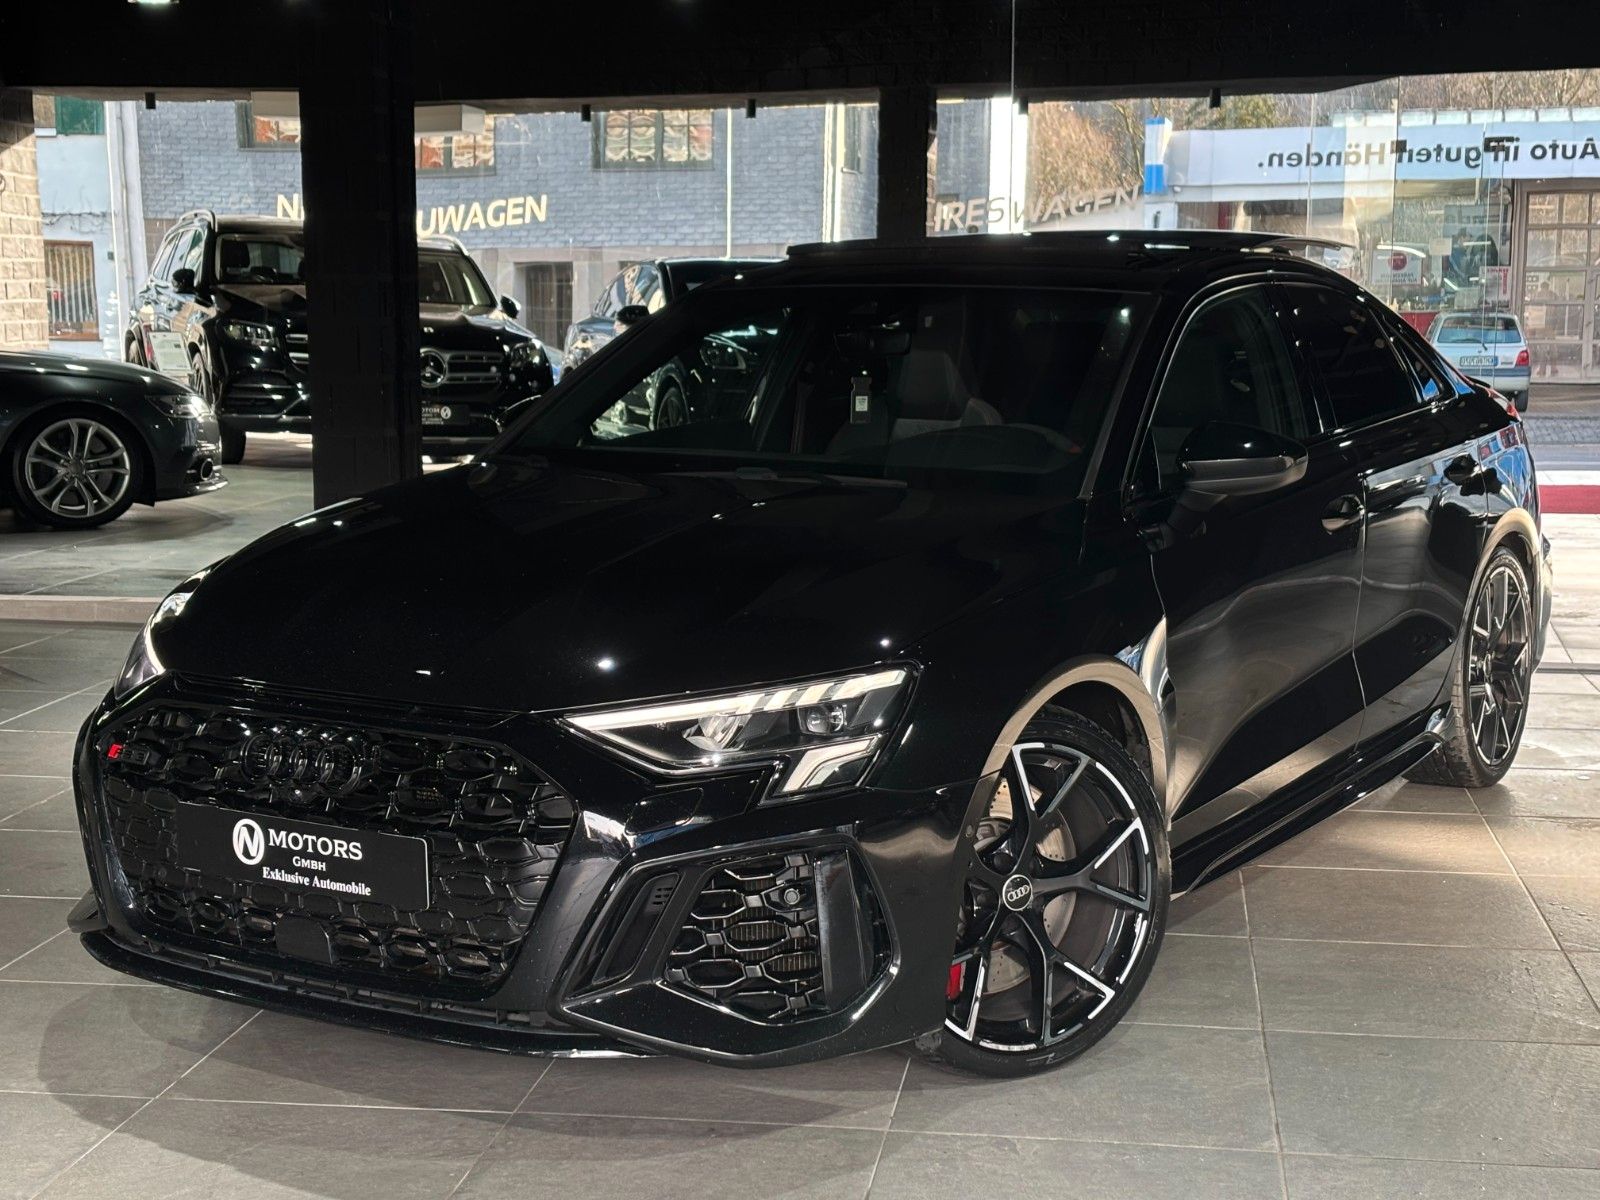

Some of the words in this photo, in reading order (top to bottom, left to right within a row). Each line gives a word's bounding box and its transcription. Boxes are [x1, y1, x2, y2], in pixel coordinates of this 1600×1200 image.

[416, 194, 547, 239] UWAGEN
[934, 184, 1142, 232] RESWAGEN
[268, 828, 363, 861] MOTORS
[292, 856, 327, 872] GMBH
[262, 866, 310, 886] Exklusive
[312, 876, 372, 896] Automobile
